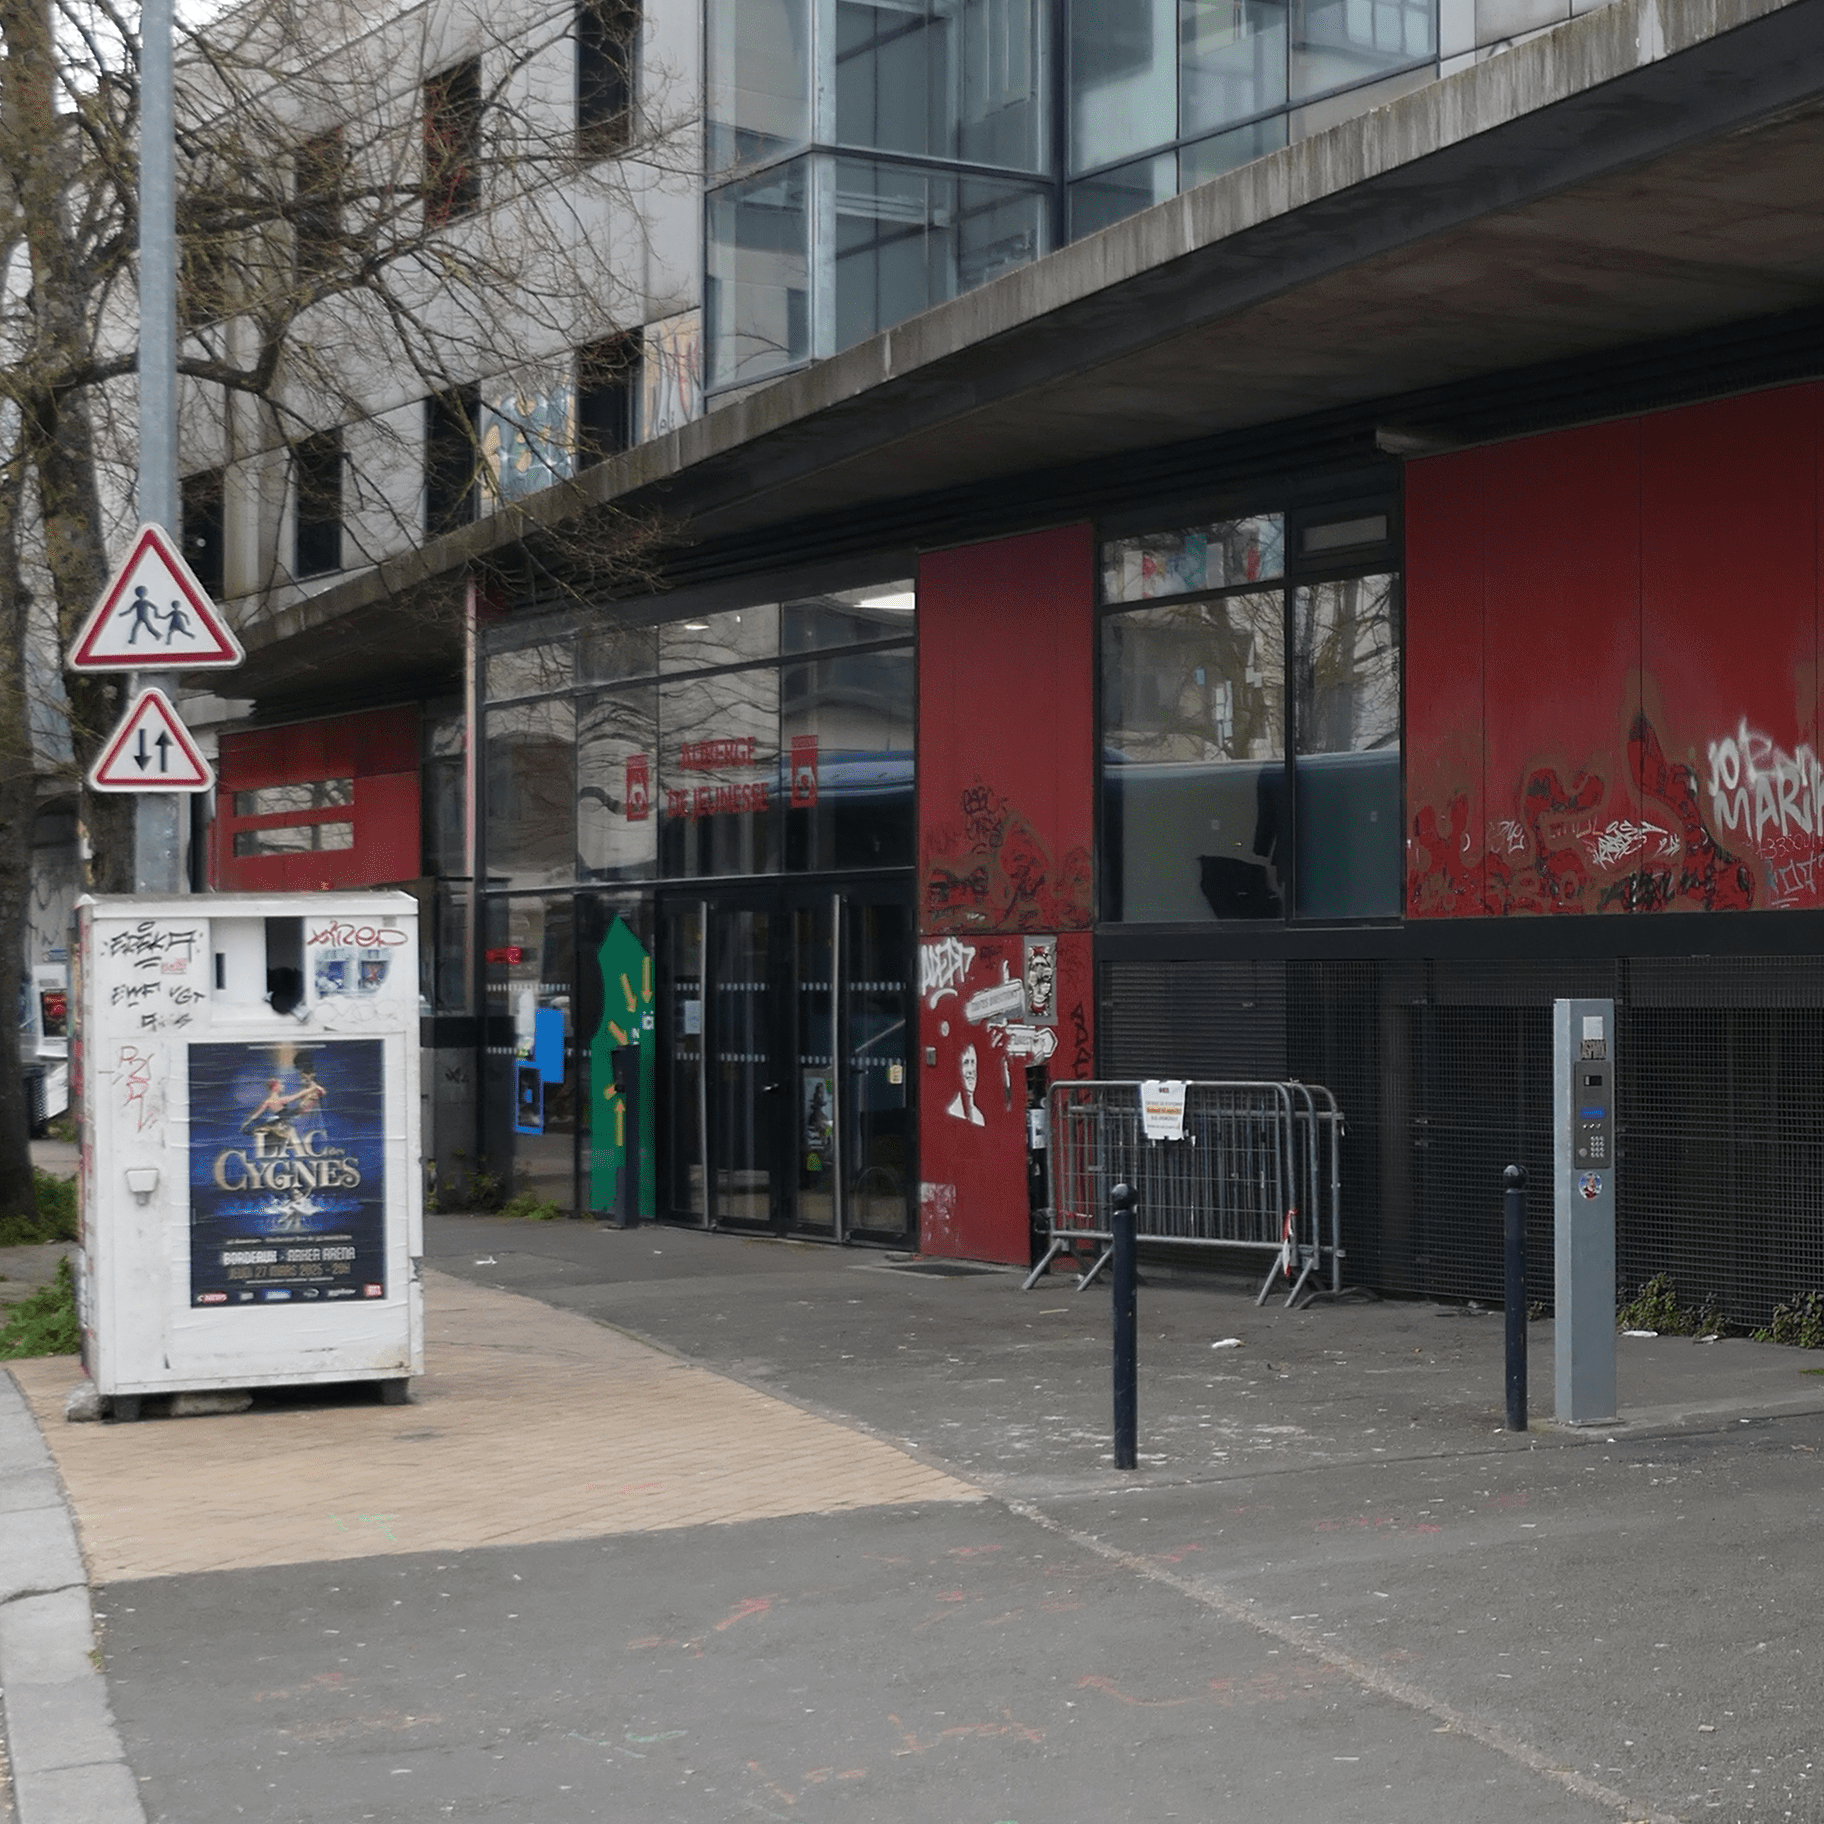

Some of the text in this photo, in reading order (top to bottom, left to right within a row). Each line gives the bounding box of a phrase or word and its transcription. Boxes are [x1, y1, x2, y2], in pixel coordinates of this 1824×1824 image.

[692, 782, 769, 823] JEUNESSE
[253, 1128, 328, 1158] LAC
[213, 1150, 361, 1191] CYGNES
